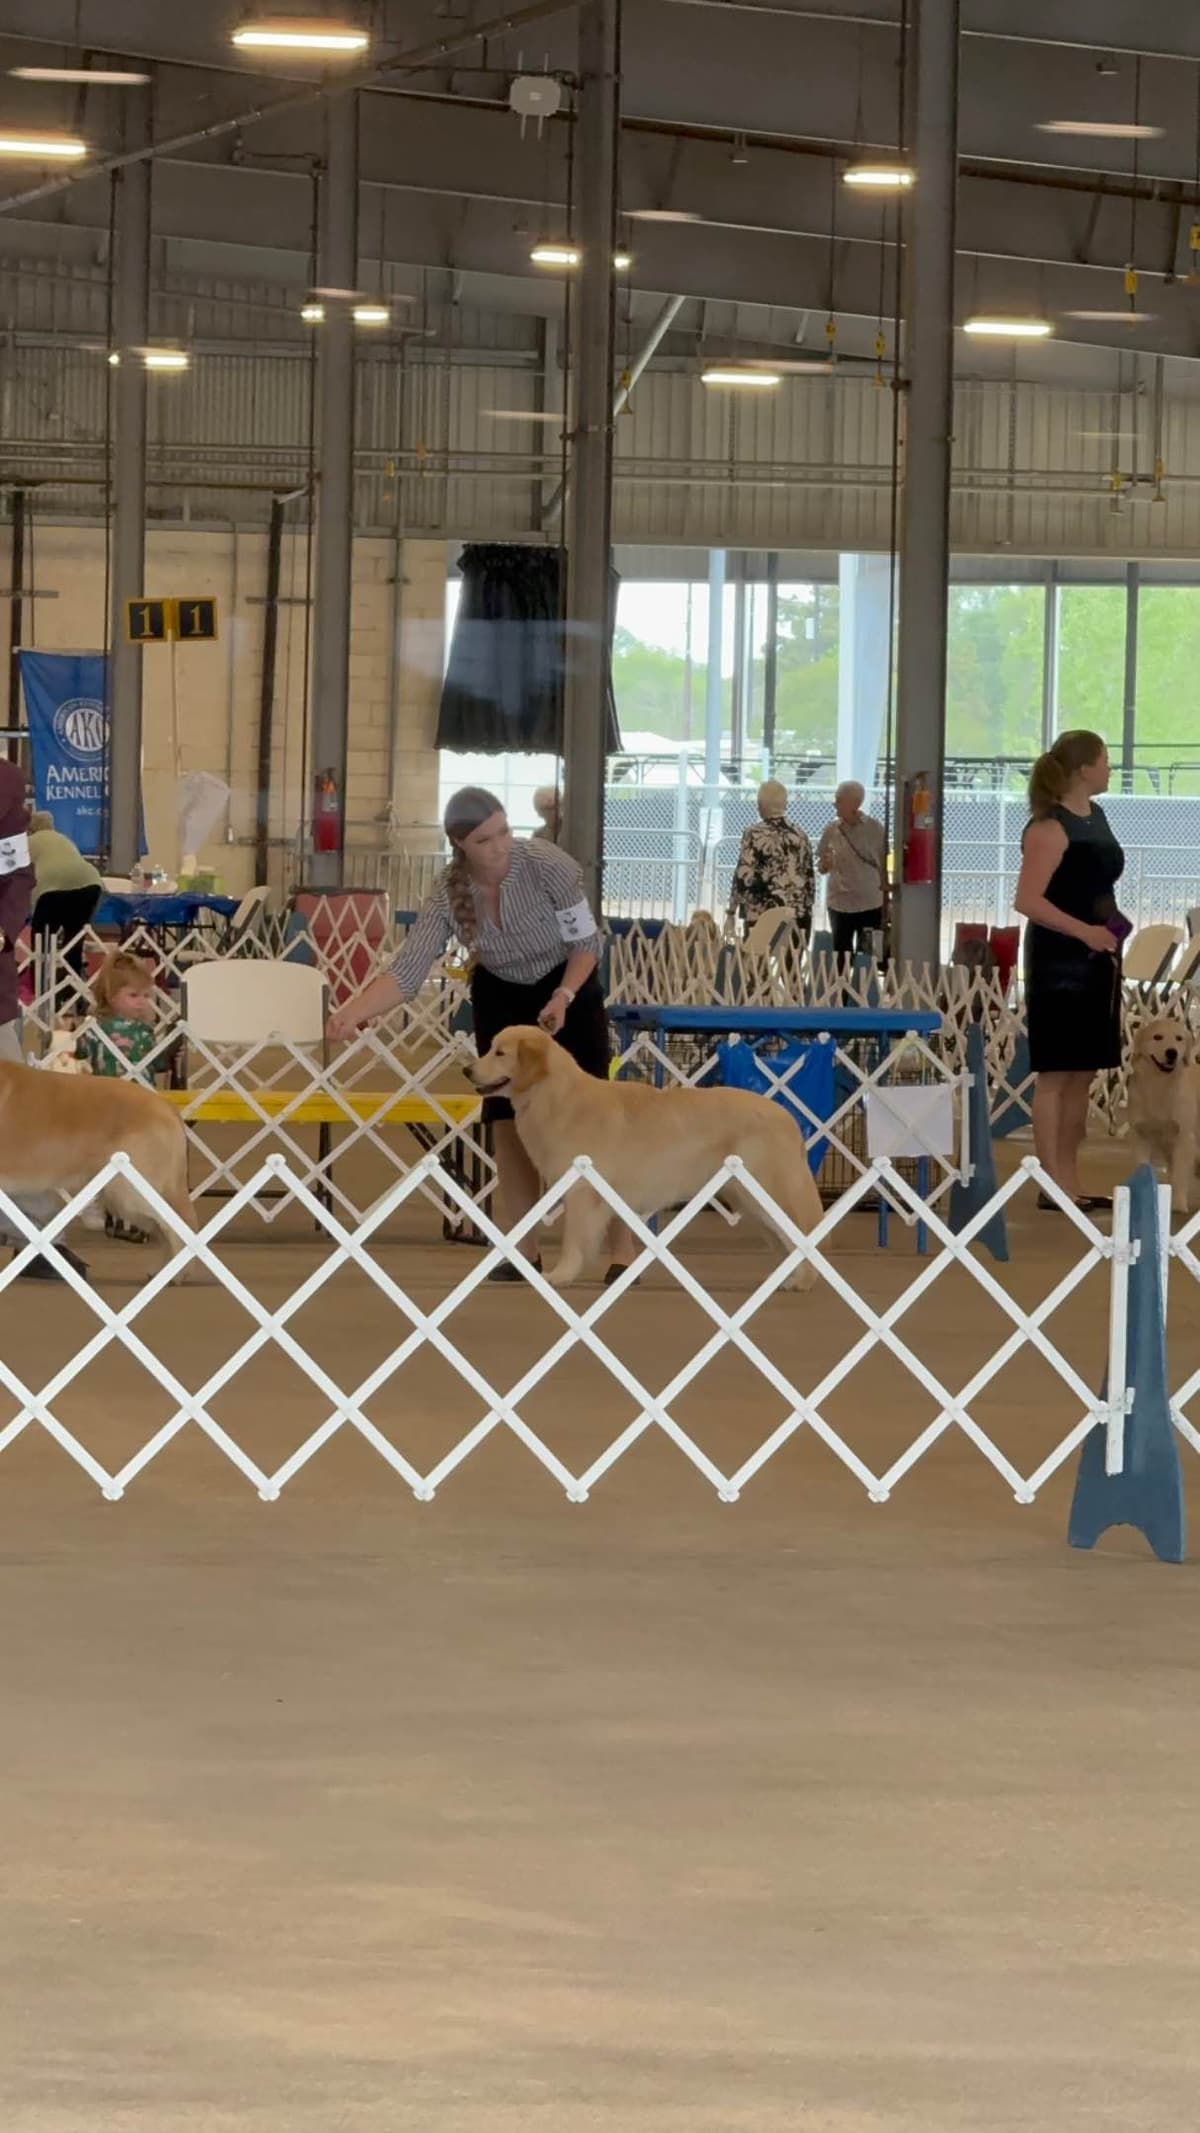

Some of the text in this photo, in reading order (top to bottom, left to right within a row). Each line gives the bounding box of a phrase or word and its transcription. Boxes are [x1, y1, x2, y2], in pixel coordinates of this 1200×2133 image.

[138, 606, 154, 635] 1
[189, 605, 204, 634] 1
[46, 785, 101, 801] KENNEL
